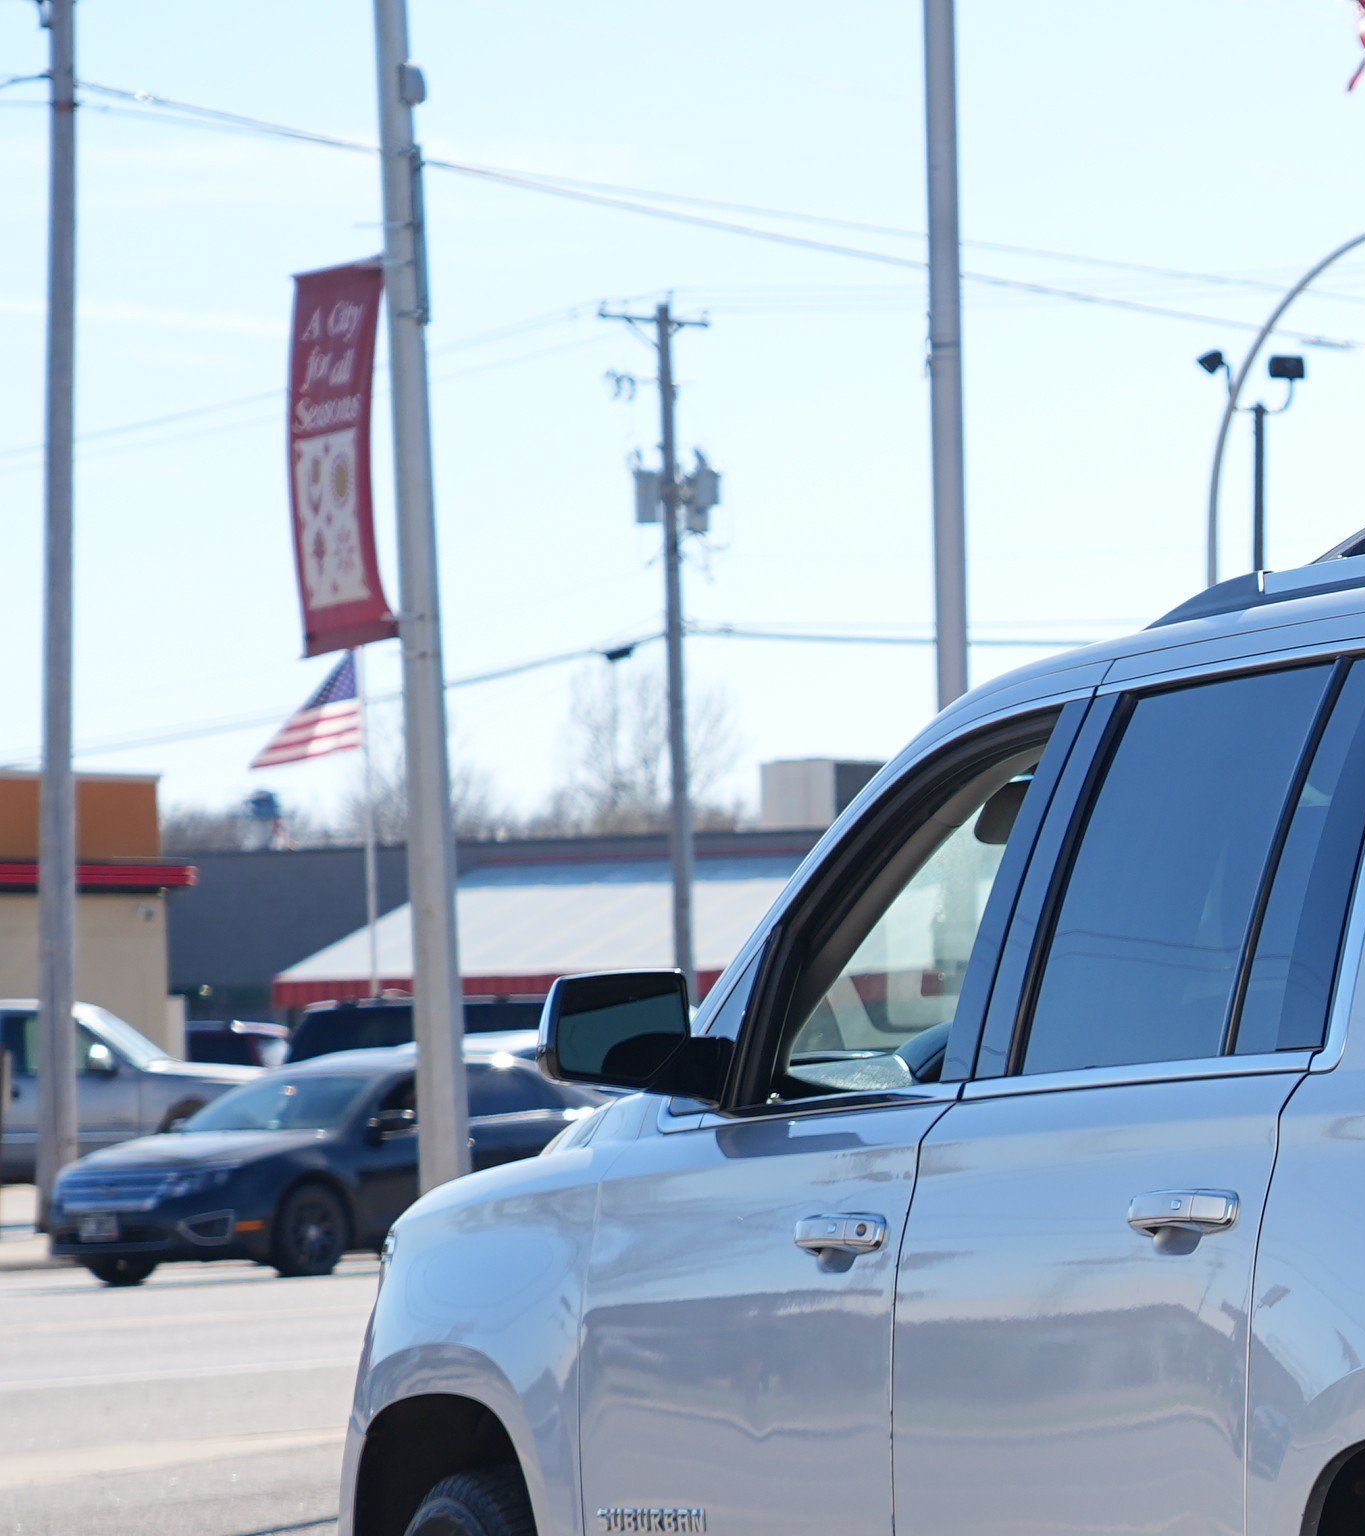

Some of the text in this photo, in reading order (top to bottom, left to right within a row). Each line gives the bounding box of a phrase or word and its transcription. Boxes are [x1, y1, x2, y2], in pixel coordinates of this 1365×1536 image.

[300, 299, 364, 342] A City
[299, 344, 333, 394] for
[597, 1508, 707, 1532] SUBURBAN
